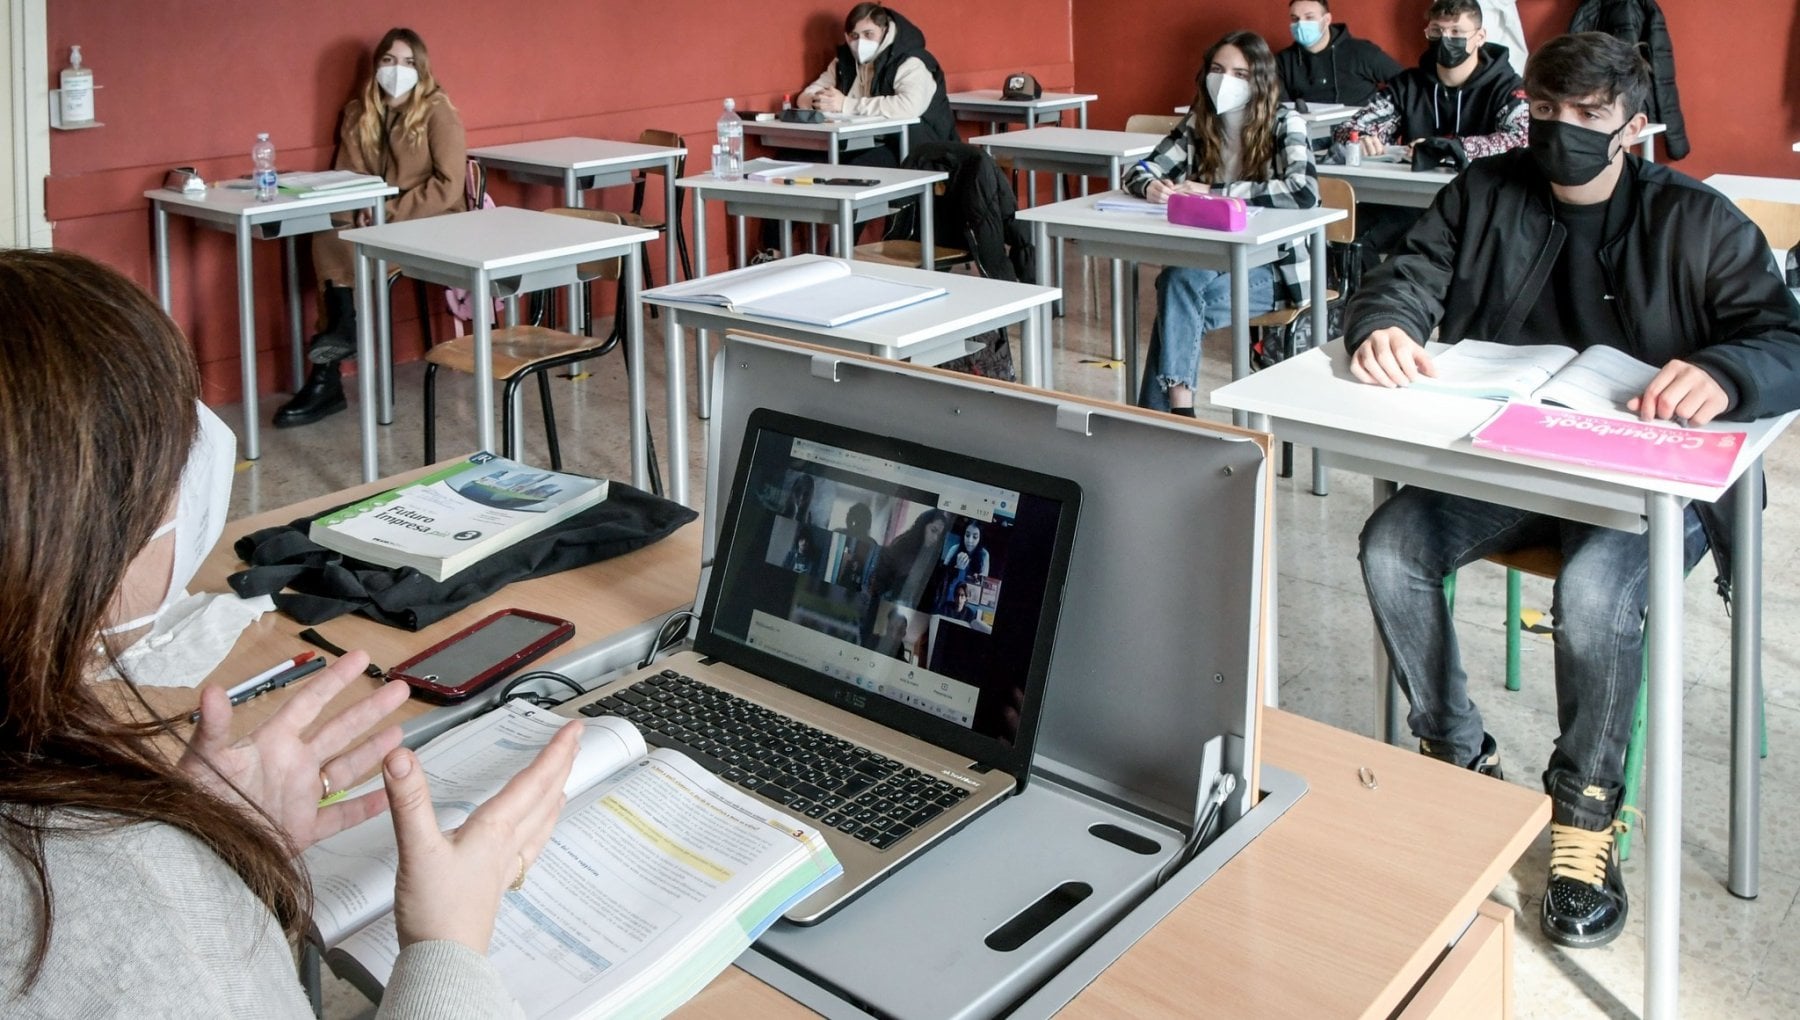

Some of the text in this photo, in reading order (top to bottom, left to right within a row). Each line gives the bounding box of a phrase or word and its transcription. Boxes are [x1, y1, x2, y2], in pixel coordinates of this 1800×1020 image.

[1539, 415, 1704, 449] Colourbook
[374, 511, 431, 533] Impresa
[387, 505, 435, 524] Futuro
[792, 829, 804, 838] 3
